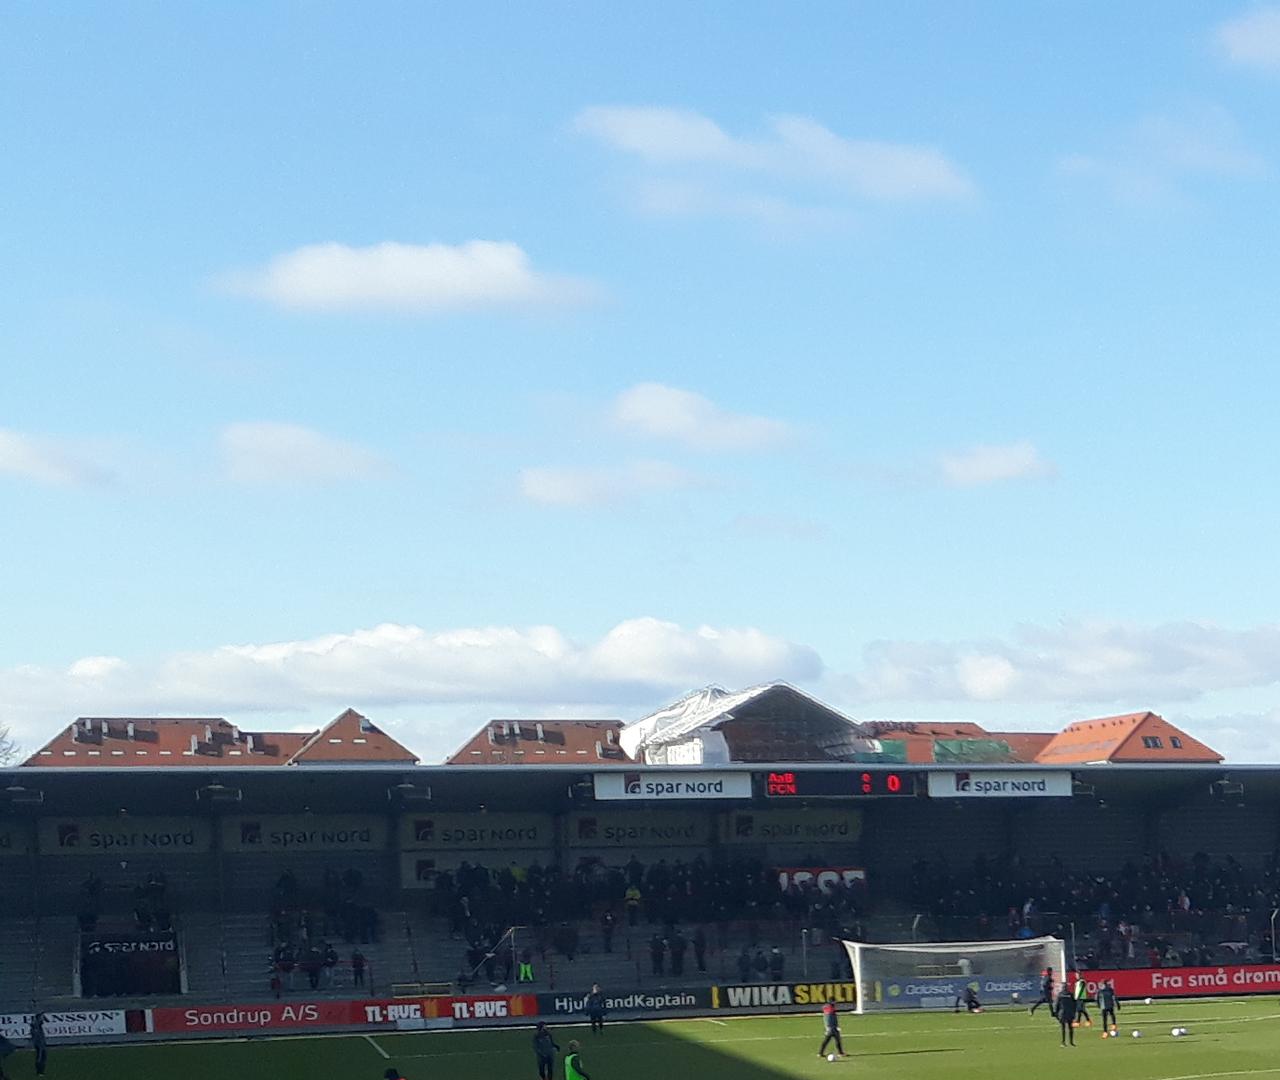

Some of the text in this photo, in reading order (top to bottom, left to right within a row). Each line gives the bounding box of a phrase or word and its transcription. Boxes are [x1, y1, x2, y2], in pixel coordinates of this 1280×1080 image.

[645, 780, 723, 796] spar Nord
[975, 778, 1046, 793] spar Nord
[1152, 973, 1183, 989] Fra
[1188, 968, 1228, 986] små
[727, 985, 793, 1007] WIKA
[185, 1005, 319, 1026] Sondrup A/S
